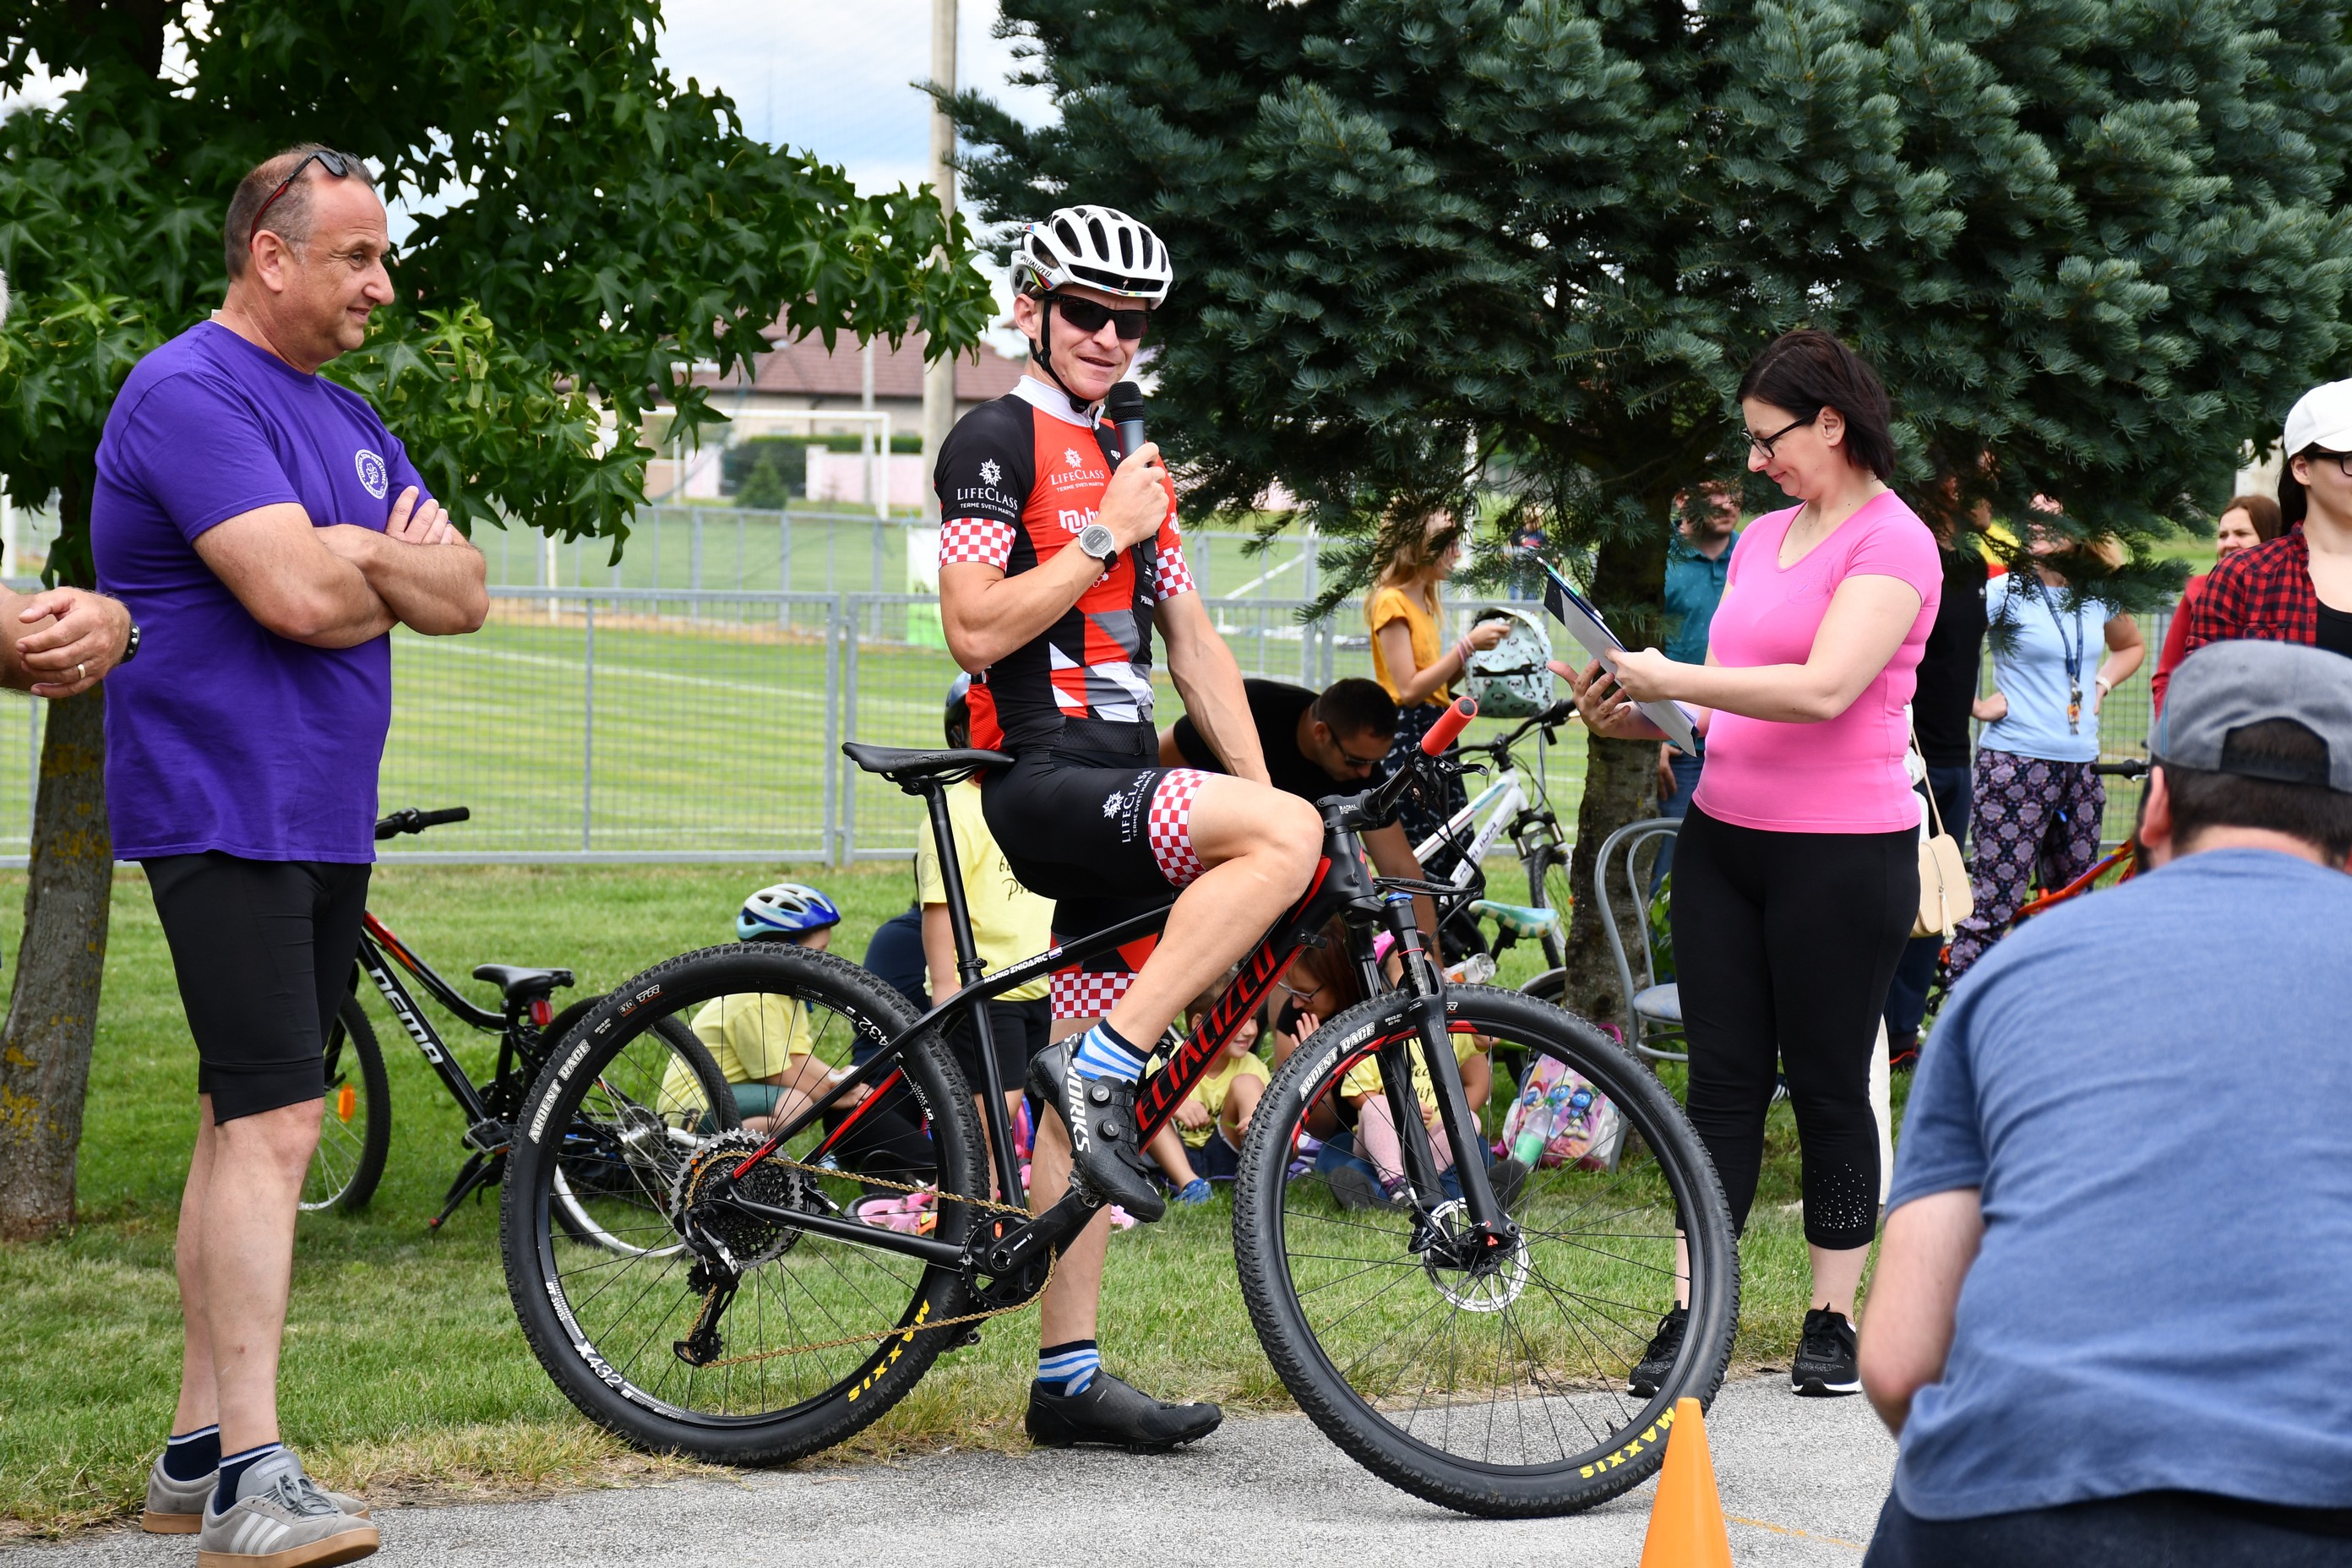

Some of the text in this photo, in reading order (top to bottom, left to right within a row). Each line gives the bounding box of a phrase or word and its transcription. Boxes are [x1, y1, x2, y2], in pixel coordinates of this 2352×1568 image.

[1020, 253, 1053, 278] SPECIALIZED
[981, 503, 997, 511] SVETI
[998, 508, 1015, 519] MARTIN
[1135, 793, 1143, 813] SVETI
[983, 953, 1048, 984] MARKO ZNIDARIC
[369, 967, 444, 1064] DEMA
[1135, 938, 1276, 1131] ECIALIZED
[1298, 1021, 1375, 1102] ARDENT RACE
[528, 1038, 591, 1144] ARDENT RACE
[913, 1081, 934, 1120] DT SWISS
[733, 1136, 777, 1179] EPIC
[546, 1282, 568, 1321] DT SWISS
[847, 1298, 930, 1402] MAXXIS
[1579, 1407, 1676, 1479] MAXXIS
